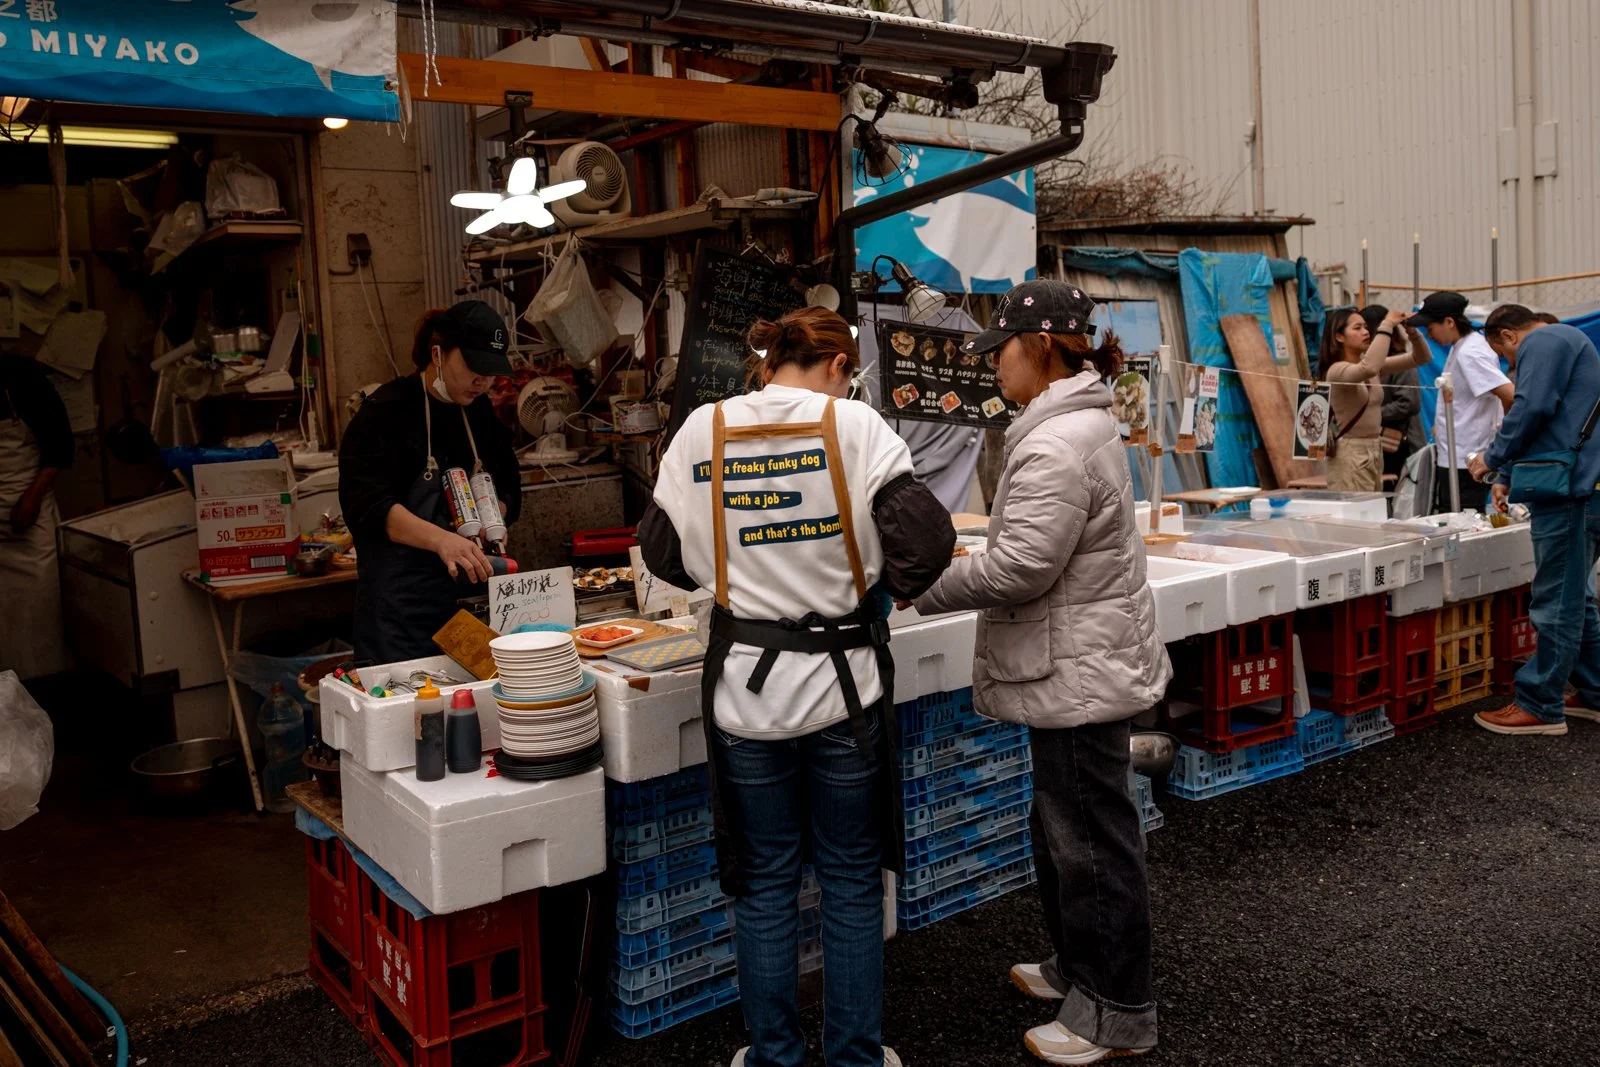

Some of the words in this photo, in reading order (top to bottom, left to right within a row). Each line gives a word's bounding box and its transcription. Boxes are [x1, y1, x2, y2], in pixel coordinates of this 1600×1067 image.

[30, 28, 200, 66] MIYAKO
[732, 462, 766, 475] freaky
[767, 457, 799, 471] funky
[801, 453, 821, 468] dog
[729, 492, 752, 507] with
[754, 496, 761, 506] a
[762, 493, 781, 509] job
[744, 528, 764, 543] and
[766, 526, 798, 540] that's
[800, 522, 818, 537] the
[1375, 565, 1386, 587] 腹
[1308, 578, 1321, 601] 腹
